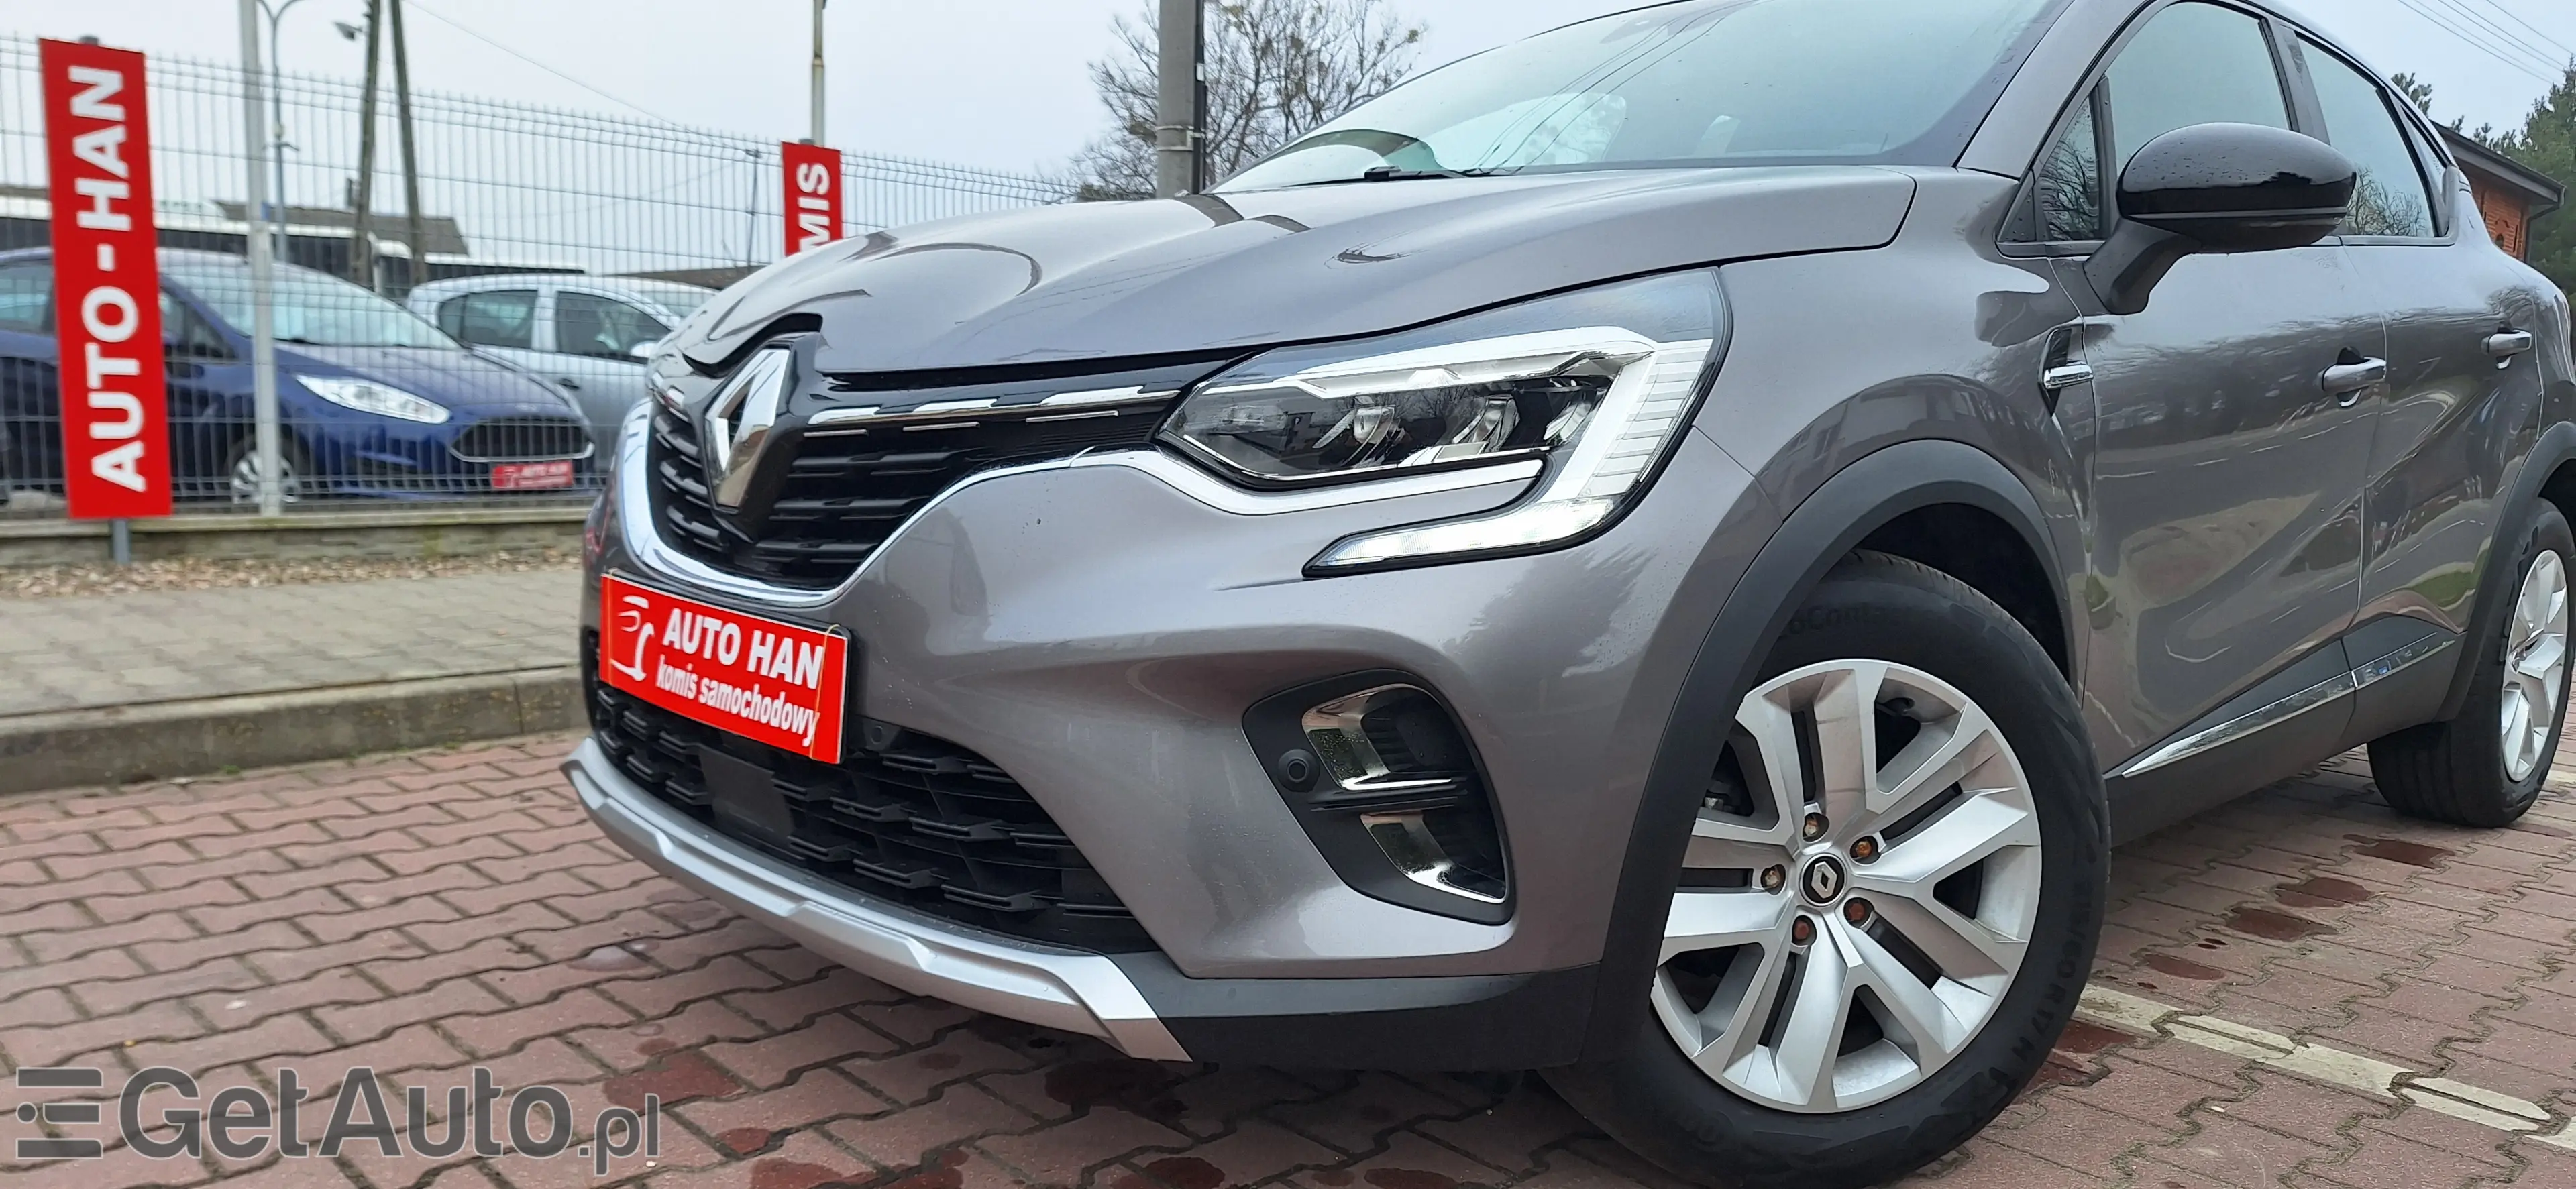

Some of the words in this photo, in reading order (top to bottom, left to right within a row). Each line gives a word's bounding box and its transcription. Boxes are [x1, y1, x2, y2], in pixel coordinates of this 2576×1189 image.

[796, 162, 830, 253] MIS
[661, 607, 741, 666] AUTO
[746, 629, 826, 689] HAN
[655, 654, 698, 700] komis
[698, 677, 820, 748] samochodowy
